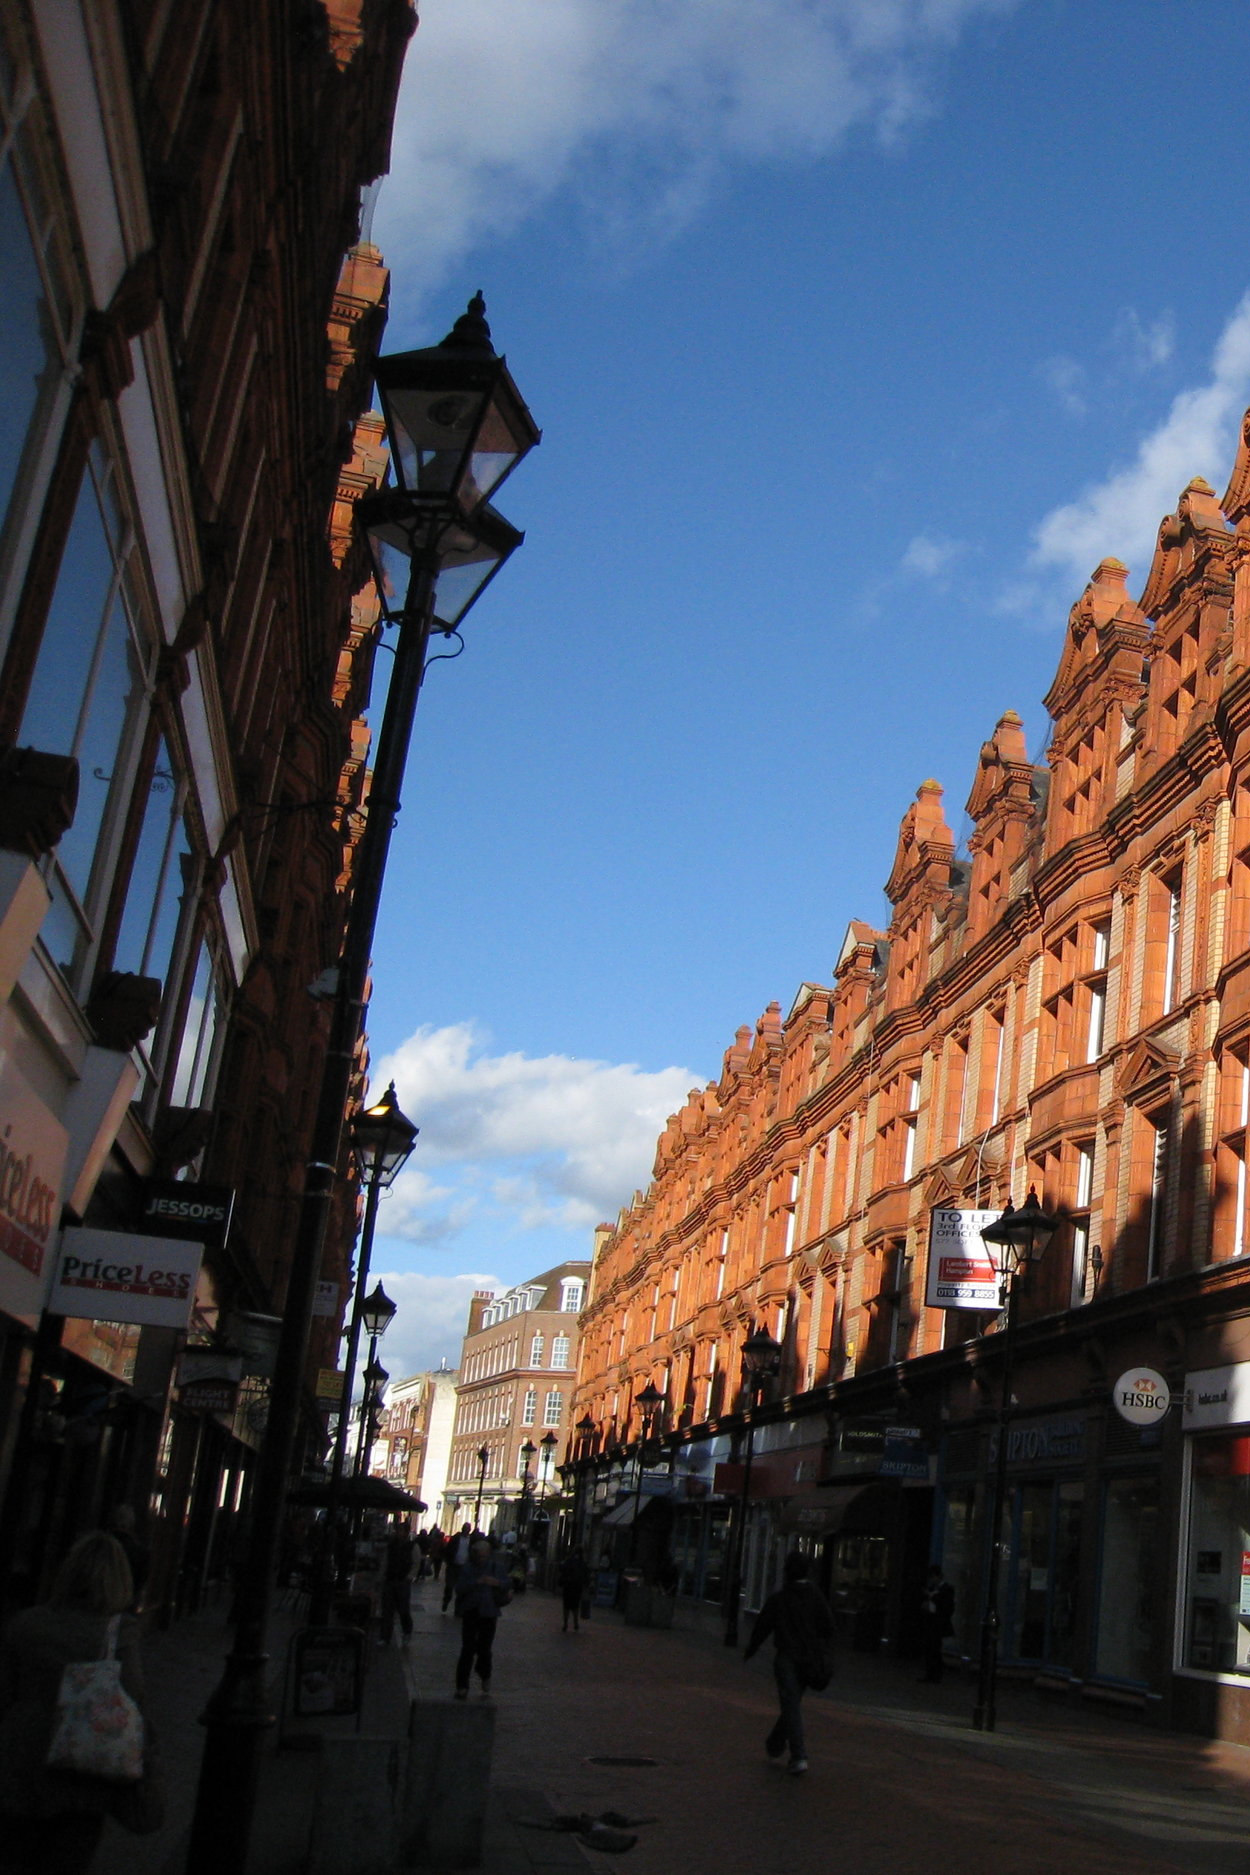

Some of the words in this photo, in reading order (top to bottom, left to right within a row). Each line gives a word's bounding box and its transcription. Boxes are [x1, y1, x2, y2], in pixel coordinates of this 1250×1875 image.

[146, 1198, 225, 1221] JESSOPS
[938, 1212, 962, 1223] TO
[945, 1268, 974, 1276] Hampton
[938, 1288, 956, 1297] 0118
[974, 1290, 995, 1299] 8855
[1122, 1392, 1167, 1410] HSBC
[989, 1429, 1048, 1464] SIPTON
[881, 1461, 928, 1475] SKIPTON
